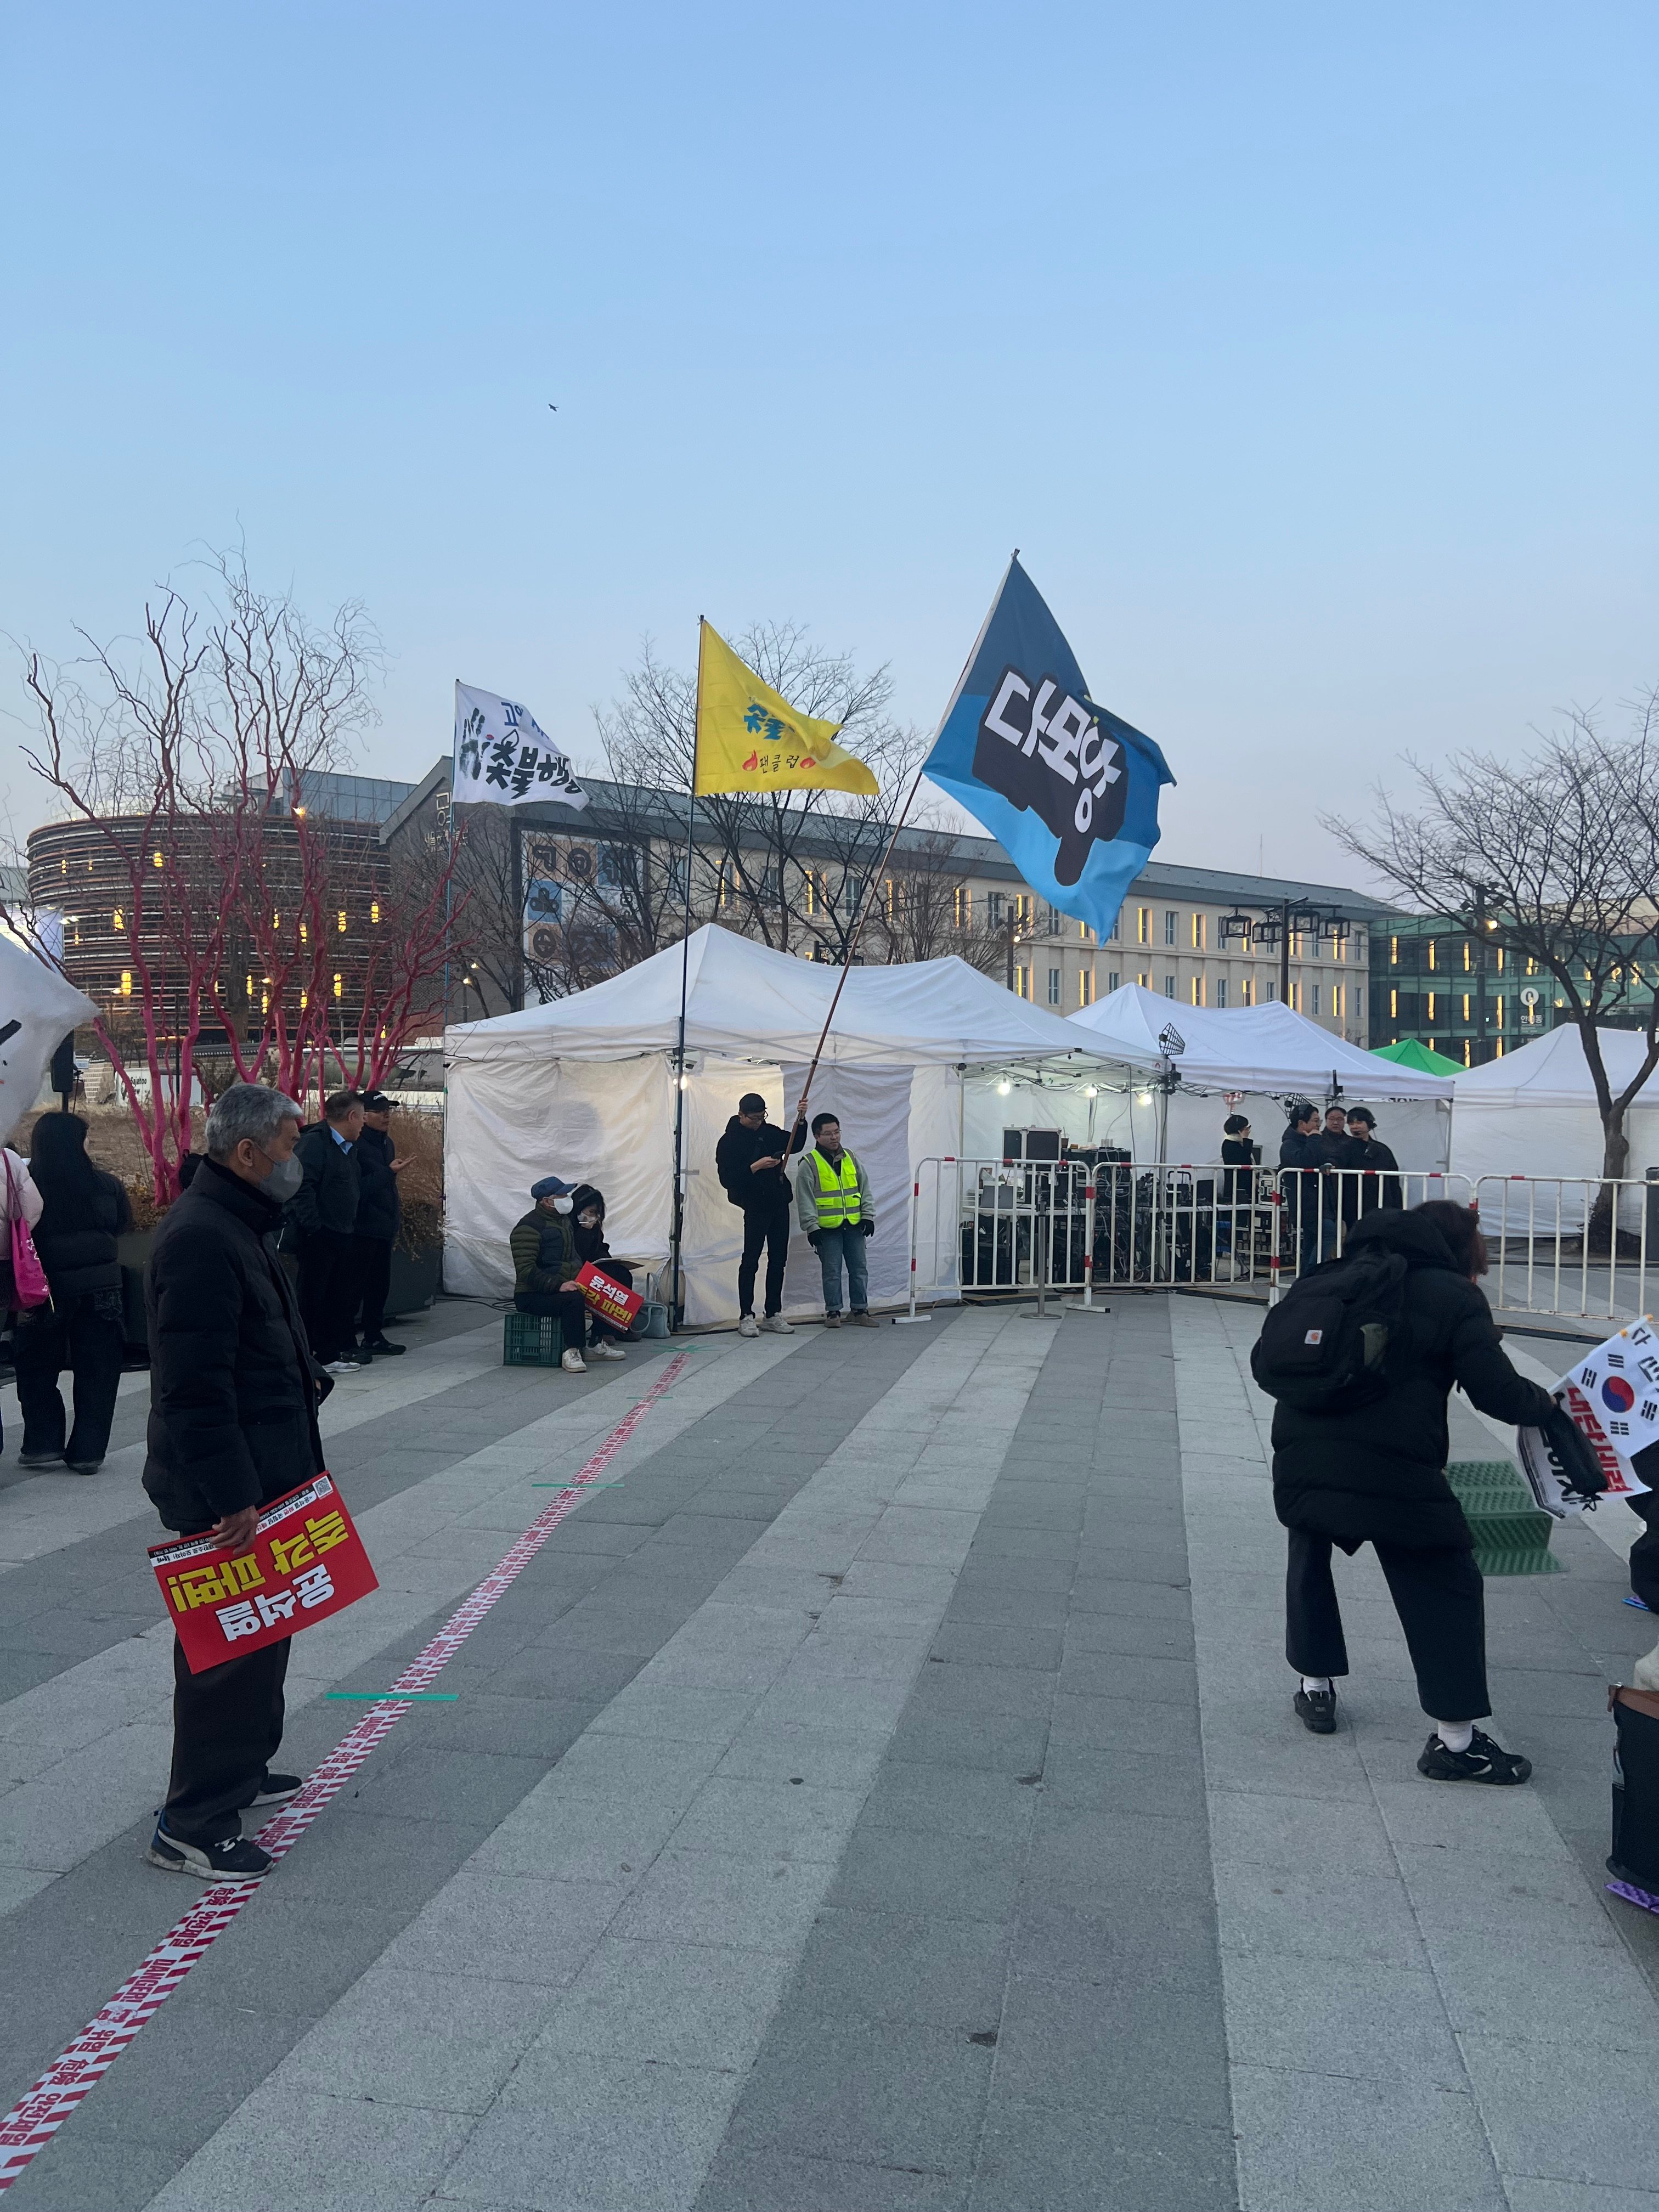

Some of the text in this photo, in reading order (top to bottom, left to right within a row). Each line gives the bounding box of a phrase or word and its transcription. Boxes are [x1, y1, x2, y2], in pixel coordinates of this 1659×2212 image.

[984, 670, 1122, 833] 다모앙
[1520, 1014, 1543, 1024] 안동
[589, 1275, 629, 1306] 윤석열
[600, 1299, 633, 1323] 파면!
[166, 1510, 349, 1613] 즉각 파면!
[216, 1563, 335, 1642] 윤석열
[354, 1716, 386, 1739] DANGER!
[331, 1751, 355, 1763] 위험
[291, 1782, 328, 1809] 안전제일
[258, 1816, 297, 1846] DANGER!
[168, 1910, 219, 1948] 안전제일
[122, 1958, 177, 2002] DANGER!
[78, 2030, 116, 2052] 위험
[0, 2092, 62, 2146] 안전제일
